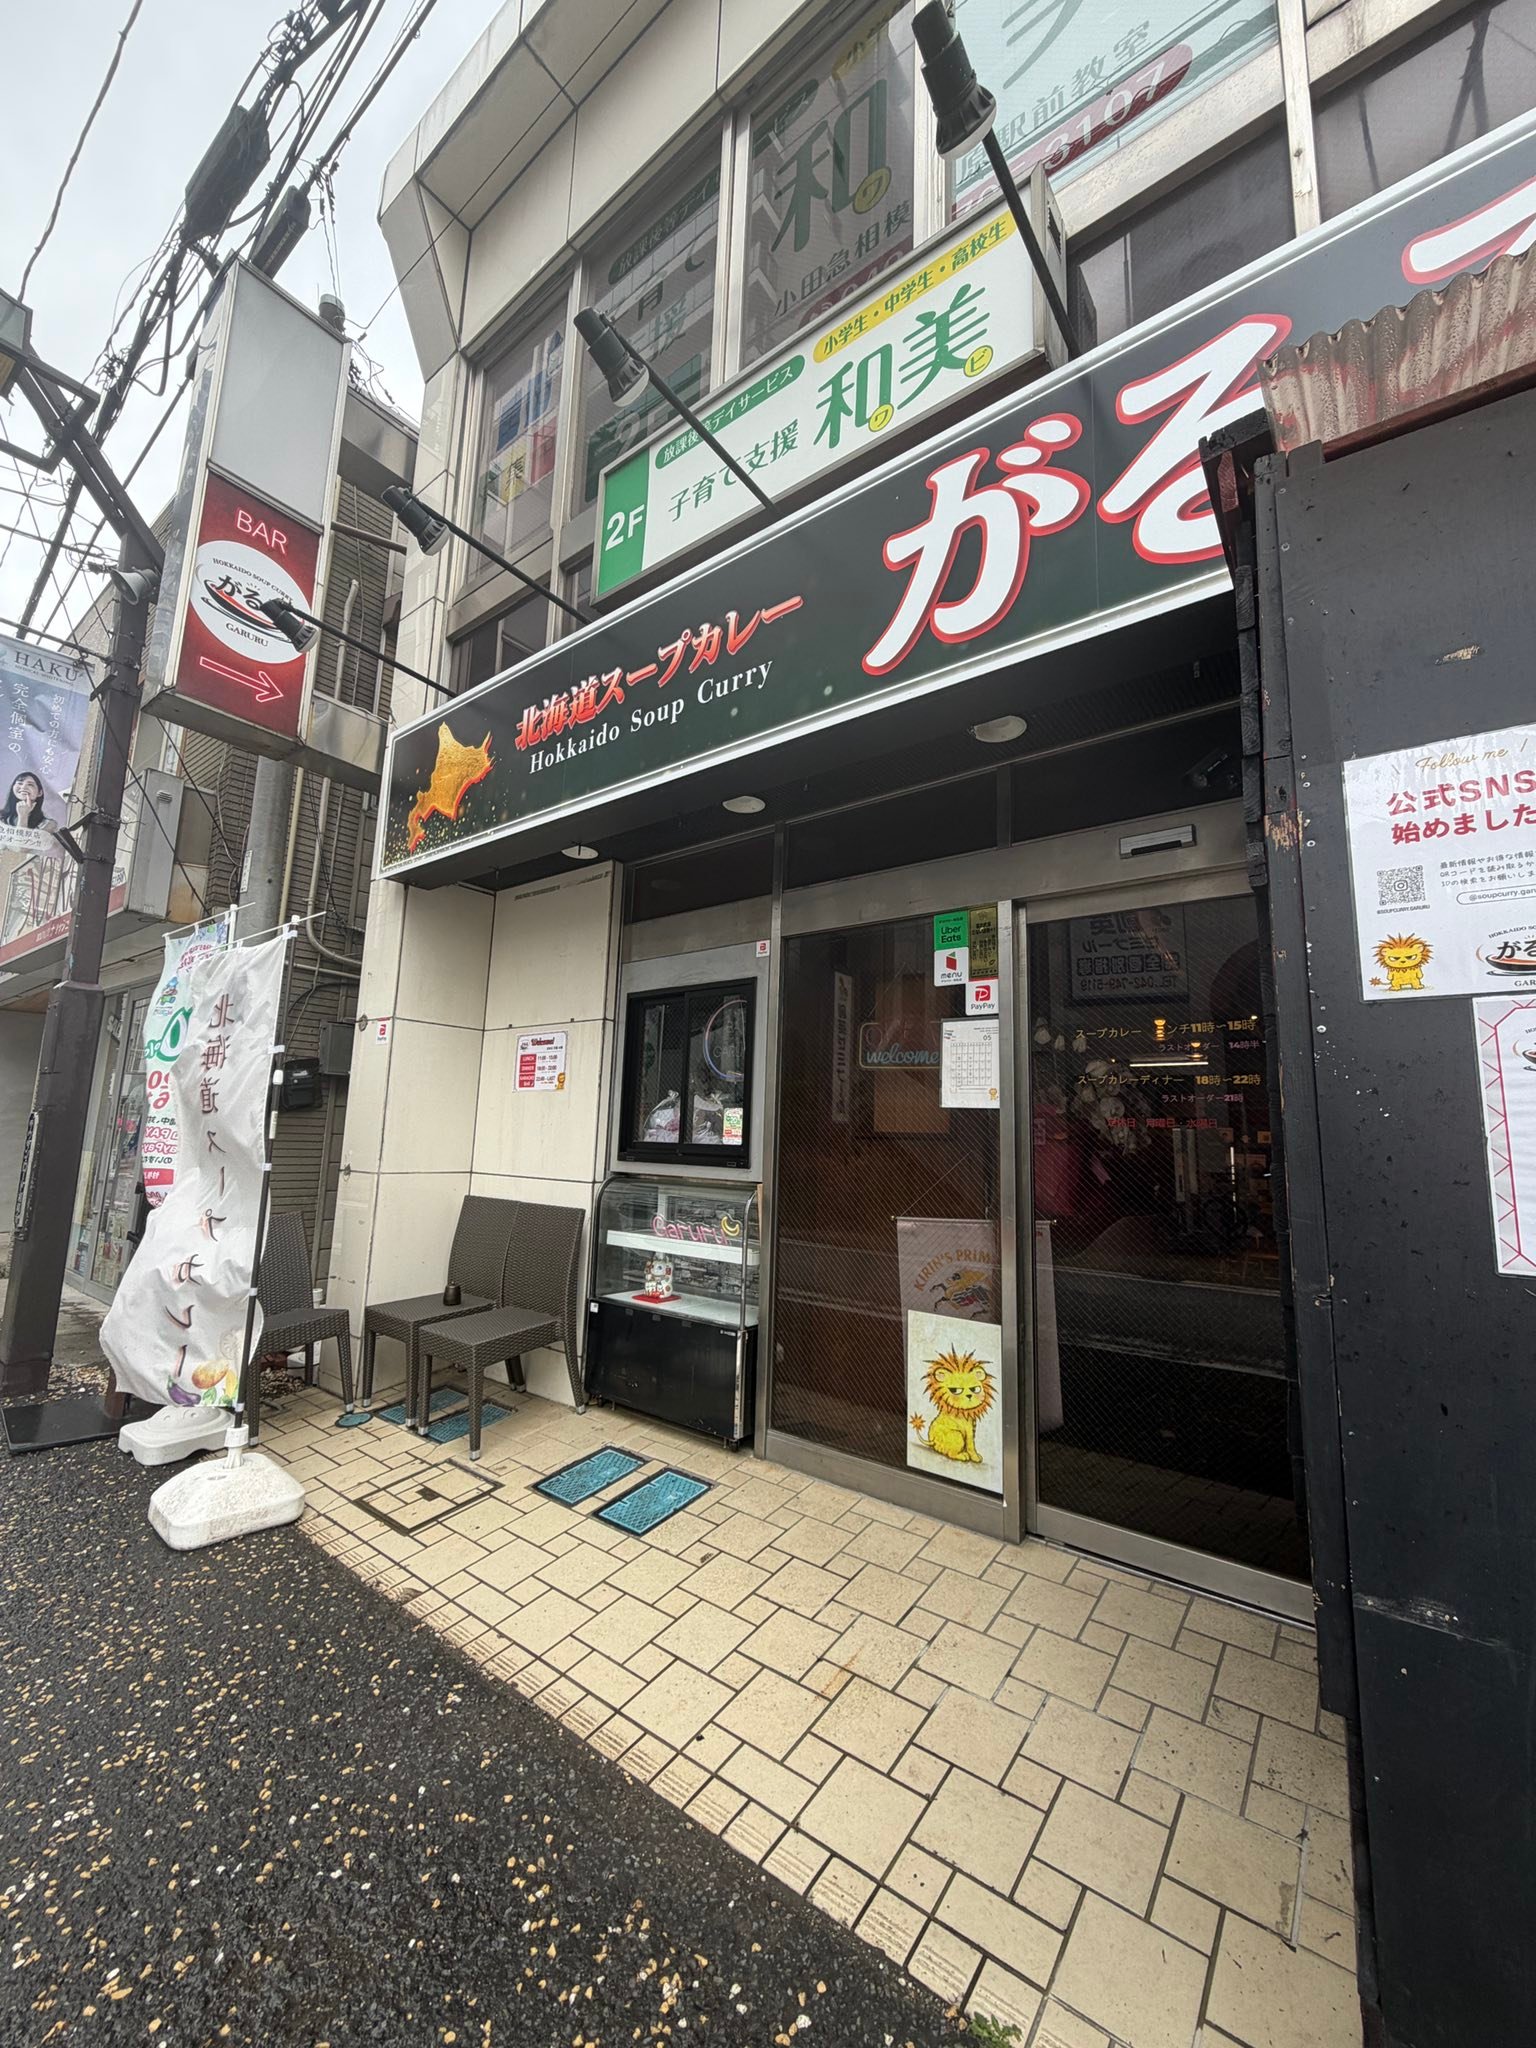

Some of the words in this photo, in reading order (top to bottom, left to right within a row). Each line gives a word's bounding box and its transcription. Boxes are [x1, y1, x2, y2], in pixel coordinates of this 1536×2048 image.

[771, 77, 887, 252] 和
[775, 201, 911, 317] 小田急相模
[823, 220, 1008, 356] 小学生・中学生・高校生
[813, 283, 991, 449] 和美
[668, 418, 799, 523] 子育て支援
[236, 509, 288, 555] BAR
[605, 504, 645, 552] 2F
[212, 557, 252, 577] HOKKAIDO
[252, 573, 271, 587] SOUP
[270, 583, 293, 602] CURRY
[215, 574, 263, 612] がる
[225, 622, 269, 647] GARURU
[14, 651, 79, 682] HAKU
[515, 595, 804, 751] 北海道スープカレー
[8, 682, 30, 755] 完全個室の
[529, 721, 621, 775] Hokkaido
[630, 698, 685, 733] Soup
[697, 660, 773, 706] Curry
[1415, 752, 1477, 773] Follow
[1482, 746, 1508, 760] me
[1386, 769, 1536, 817] 公式SNS
[1390, 803, 1536, 845] 始めました
[940, 934, 962, 944] Eats
[941, 925, 962, 935] Uber
[1488, 925, 1527, 939] HOKKAIDO
[940, 971, 963, 979] menu
[970, 1002, 996, 1011] PayPay
[866, 1042, 940, 1064] welcome
[1076, 1028, 1142, 1039] スープカレー
[1160, 1042, 1221, 1052] ラストオダー
[1078, 1074, 1185, 1085] スープカレーディナー
[652, 1214, 729, 1245] Garuru
[914, 1251, 953, 1293] KIRIN'S
